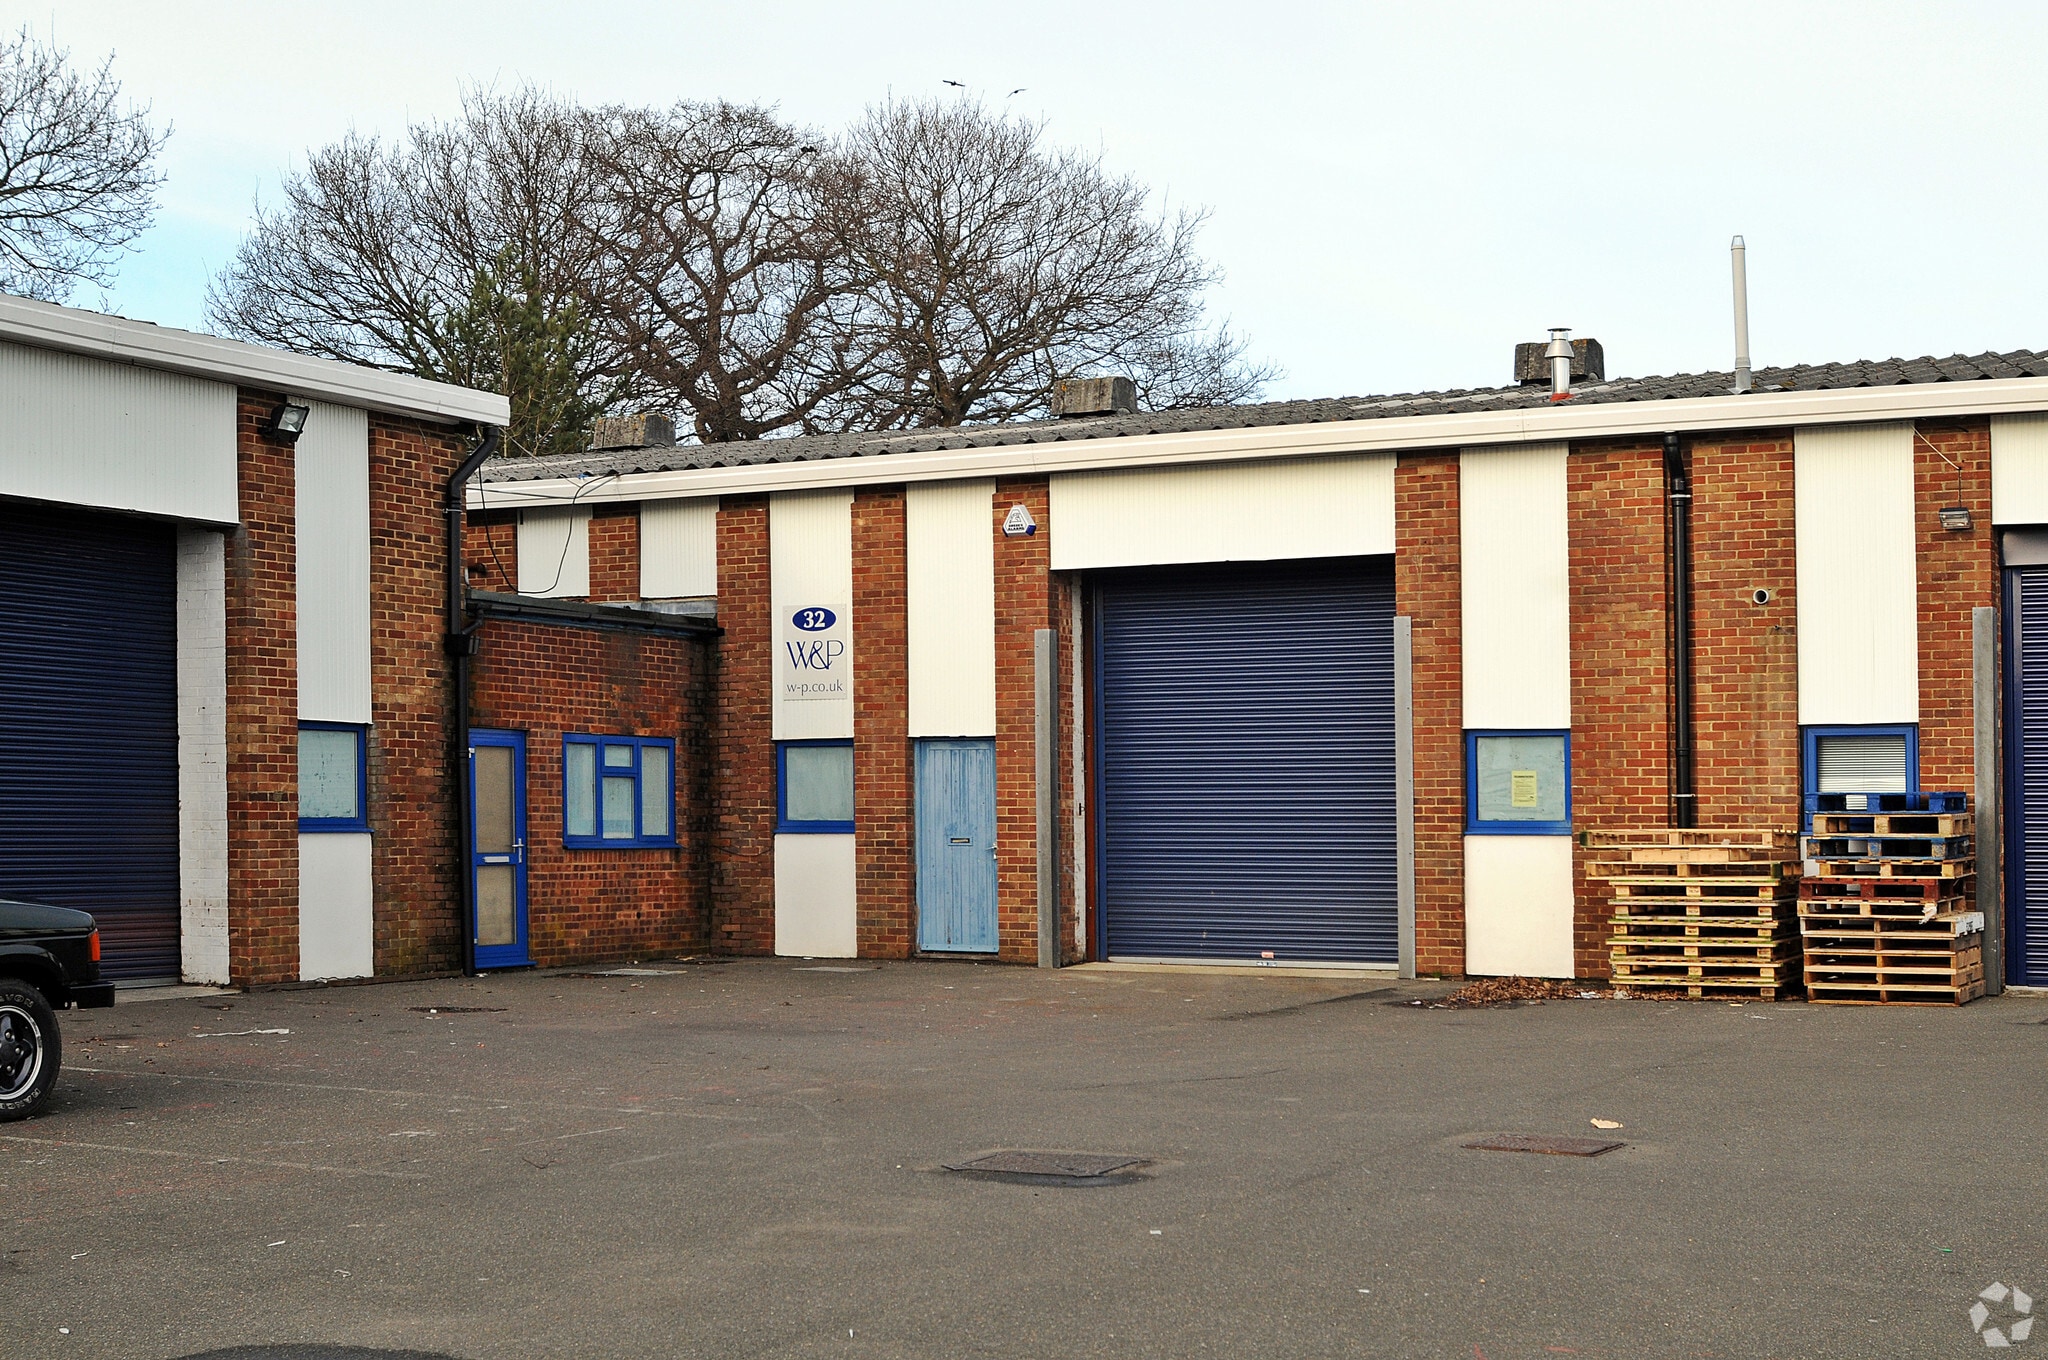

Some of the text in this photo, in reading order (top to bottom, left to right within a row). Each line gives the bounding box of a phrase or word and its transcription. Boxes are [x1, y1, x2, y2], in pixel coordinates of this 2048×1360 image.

[803, 610, 826, 629] 32
[785, 639, 844, 671] W&P
[786, 679, 844, 697] w-p.co.uk
